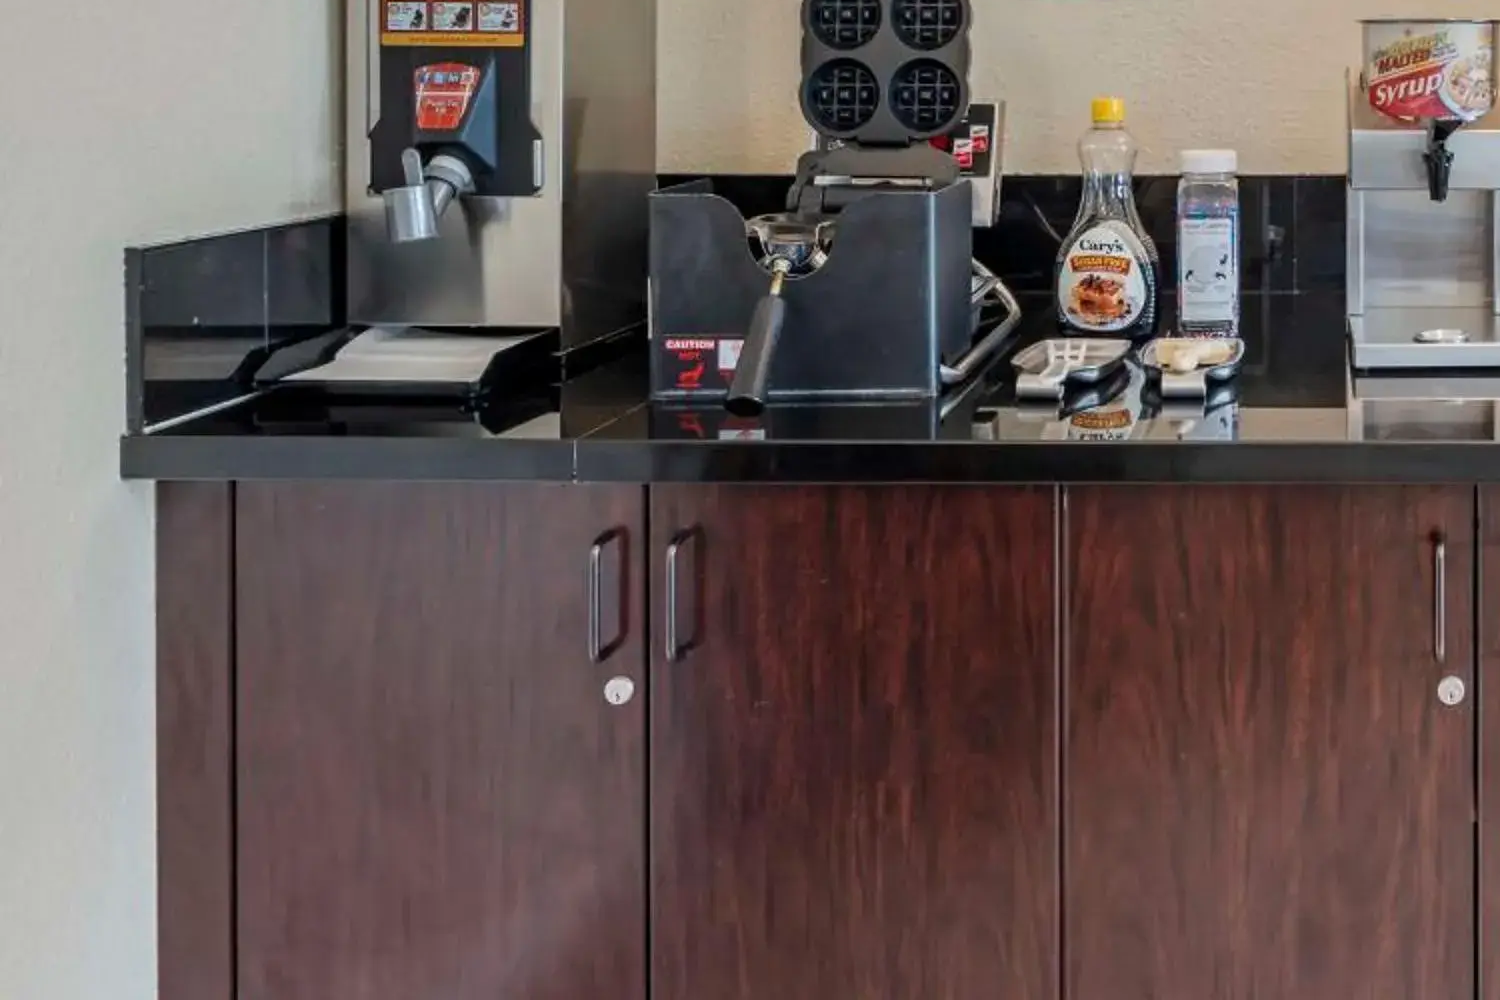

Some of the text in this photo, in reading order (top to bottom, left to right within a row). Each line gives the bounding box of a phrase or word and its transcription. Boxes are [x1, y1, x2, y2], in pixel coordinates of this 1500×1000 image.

[1376, 73, 1443, 107] Syrup
[1079, 239, 1124, 254] Cary's
[665, 339, 715, 349] CAUTION
